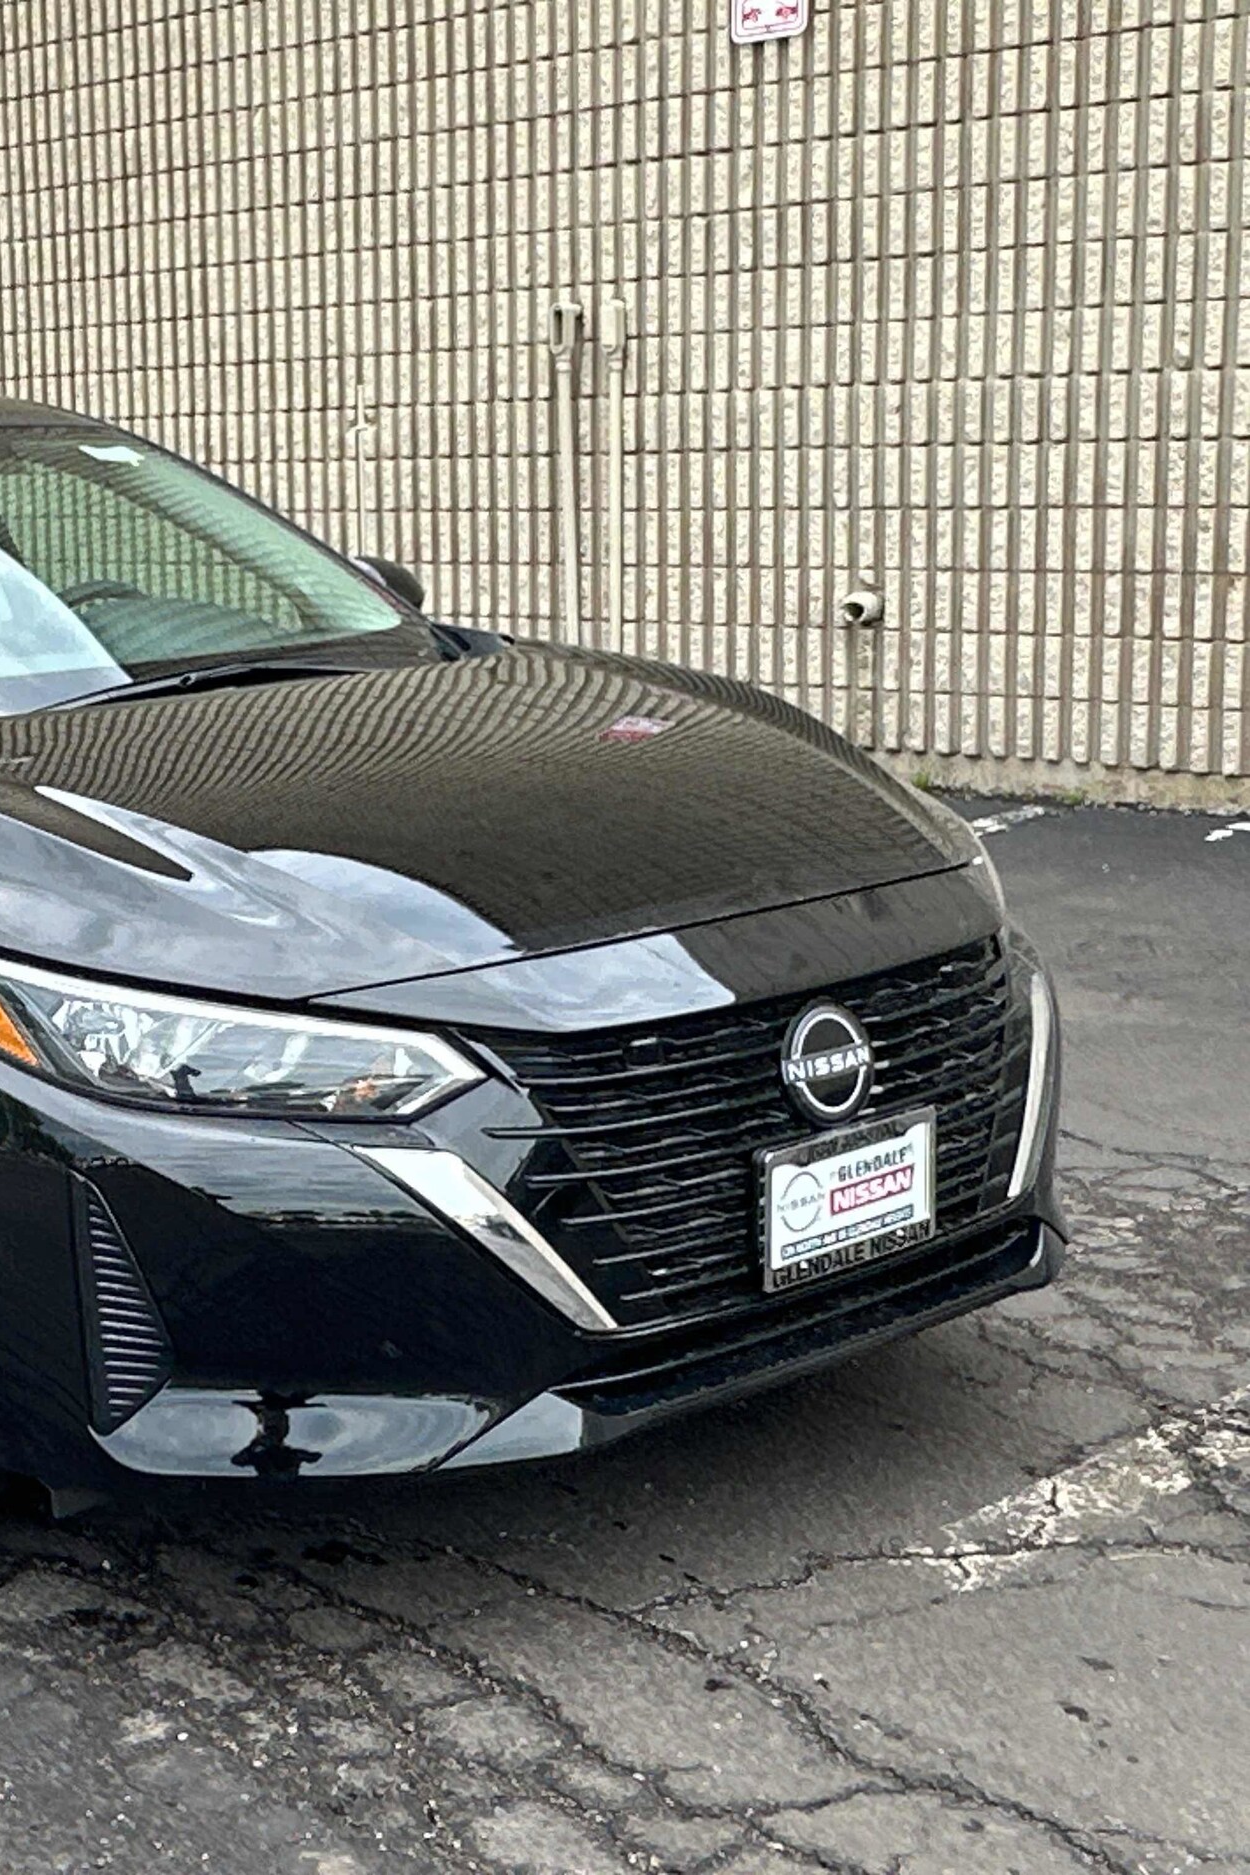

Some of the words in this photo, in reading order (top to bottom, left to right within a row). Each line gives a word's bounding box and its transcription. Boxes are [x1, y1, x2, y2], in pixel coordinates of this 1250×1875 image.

[787, 1045, 870, 1081] NISSAN
[838, 1146, 907, 1182] GLENDALE
[777, 1191, 825, 1213] NISSAN
[832, 1168, 912, 1212] NISSAN
[774, 1239, 866, 1288] GLENDALE
[870, 1221, 930, 1255] NISSAN
